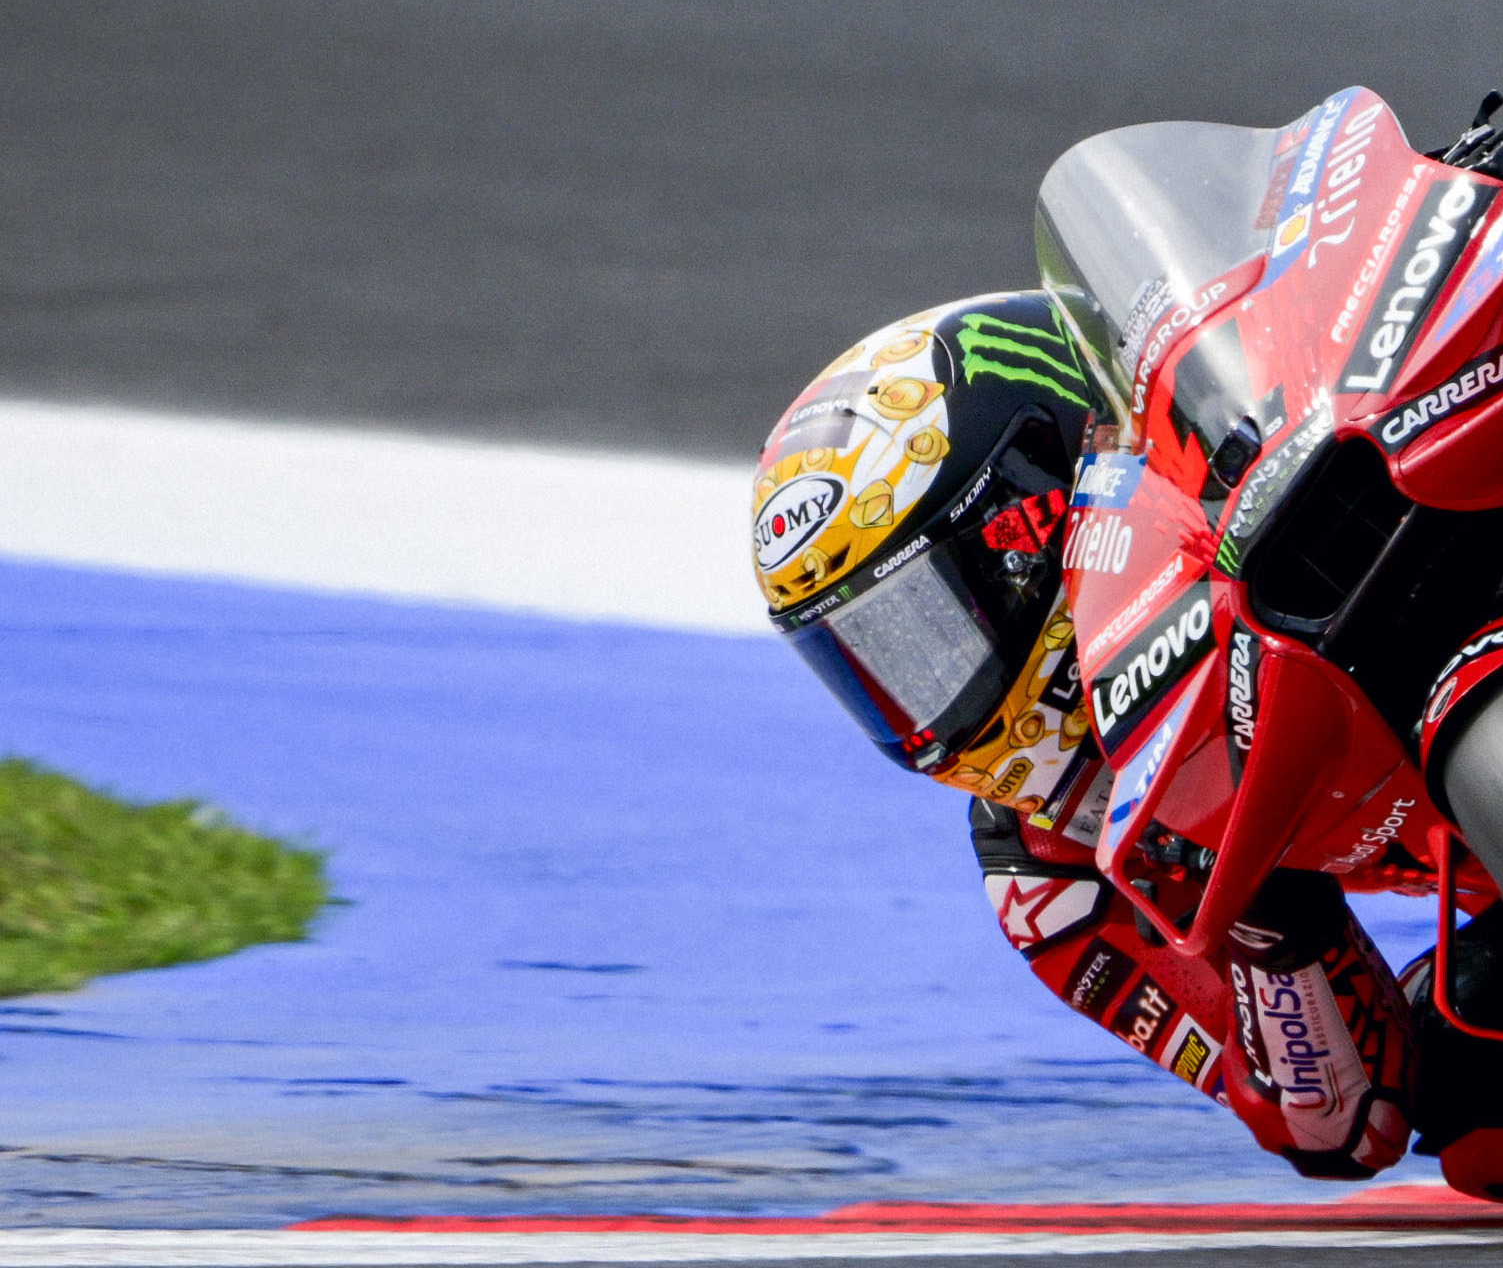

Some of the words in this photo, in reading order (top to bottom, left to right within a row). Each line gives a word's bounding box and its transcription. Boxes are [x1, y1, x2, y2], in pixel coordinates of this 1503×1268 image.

[1330, 164, 1424, 343] FRECCIAROSSA
[1345, 176, 1476, 390] Lenovo
[1133, 282, 1227, 414] VARGROUP
[754, 490, 832, 554] SUOMY
[950, 465, 992, 523] SUOMY
[873, 534, 931, 580] CARRERA
[1084, 554, 1183, 663] FRECCIAROSSA
[1092, 599, 1211, 737] Lenovo
[1230, 632, 1254, 751] CARRERA
[991, 762, 1029, 800] COTTO
[1134, 722, 1173, 795] TIM
[1361, 798, 1416, 845] Sport
